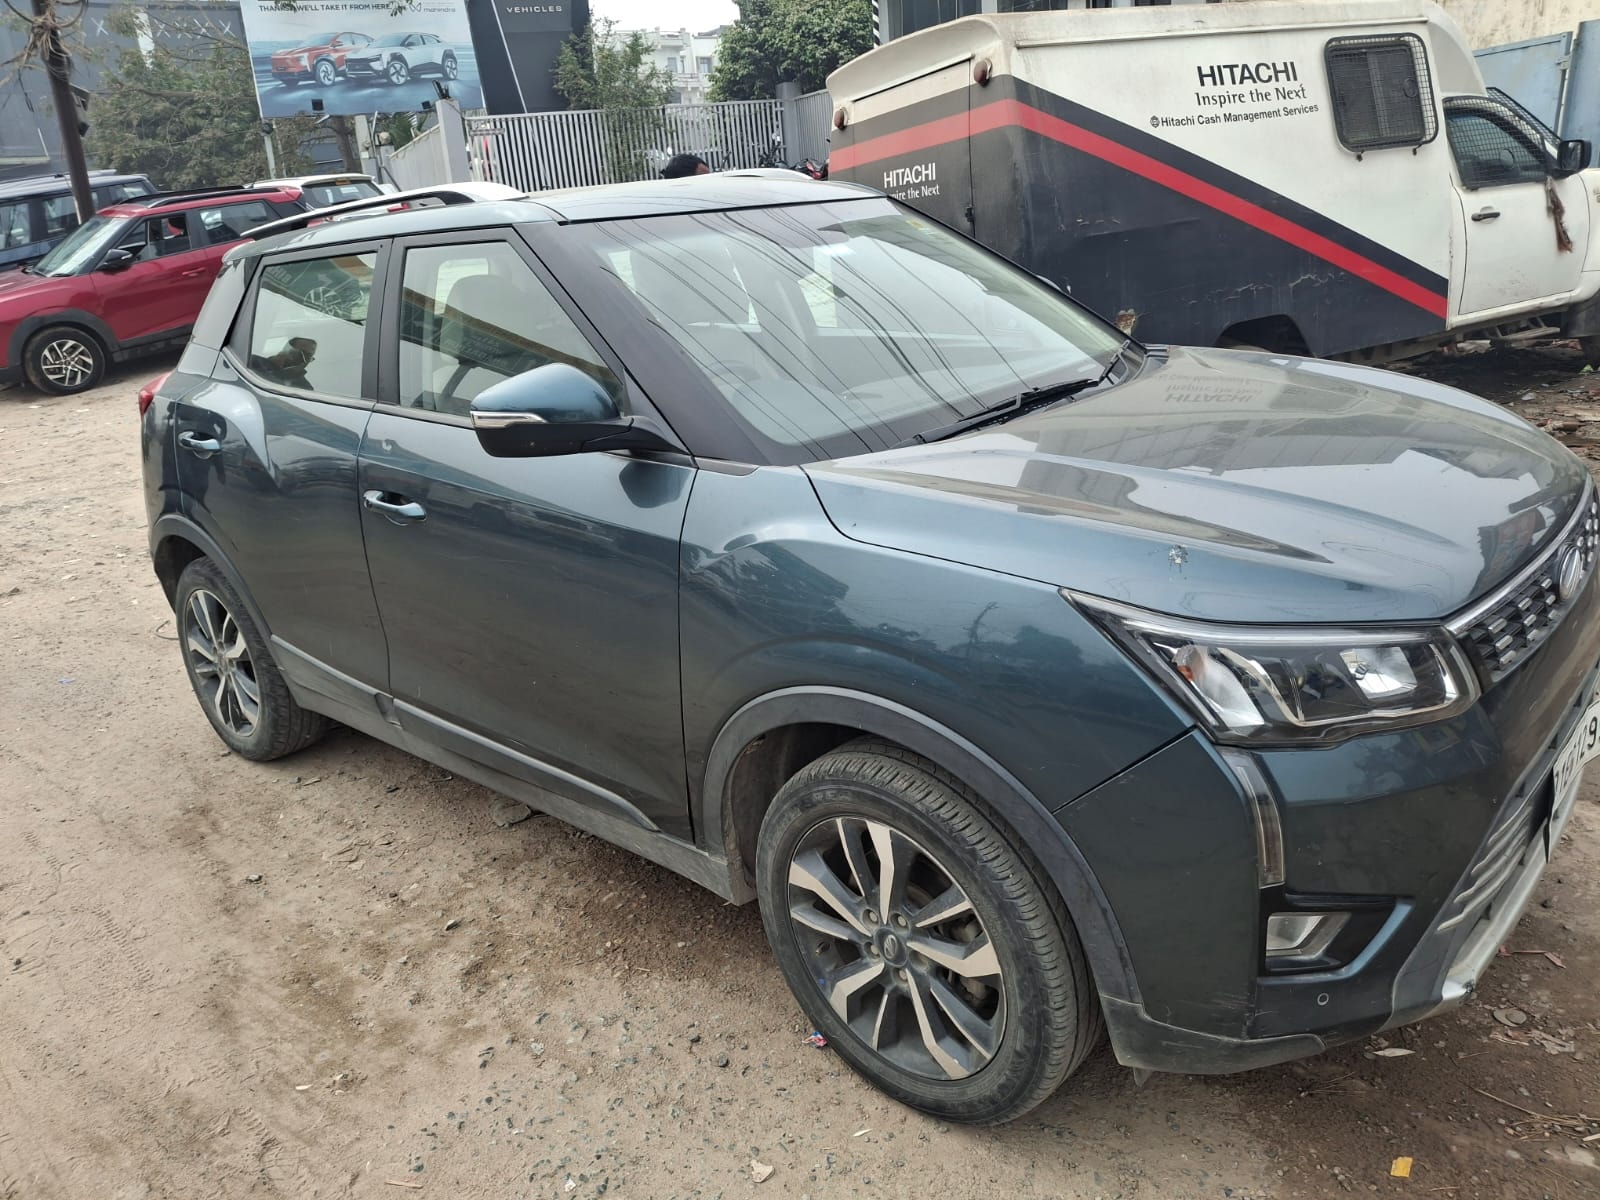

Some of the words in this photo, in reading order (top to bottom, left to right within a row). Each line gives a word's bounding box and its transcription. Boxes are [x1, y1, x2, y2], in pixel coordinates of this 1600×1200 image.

[506, 5, 562, 13] VEHICLES
[1197, 61, 1298, 87] HITACHI
[1194, 90, 1246, 108] Inspire
[1250, 88, 1272, 103] the
[1275, 84, 1307, 101] Next
[1161, 115, 1195, 127] Hitachi
[1197, 114, 1222, 125] Cash
[1223, 108, 1282, 123] Management
[1283, 104, 1319, 117] Services
[884, 163, 936, 188] HITACHI
[907, 187, 920, 199] the
[921, 185, 940, 197] Next
